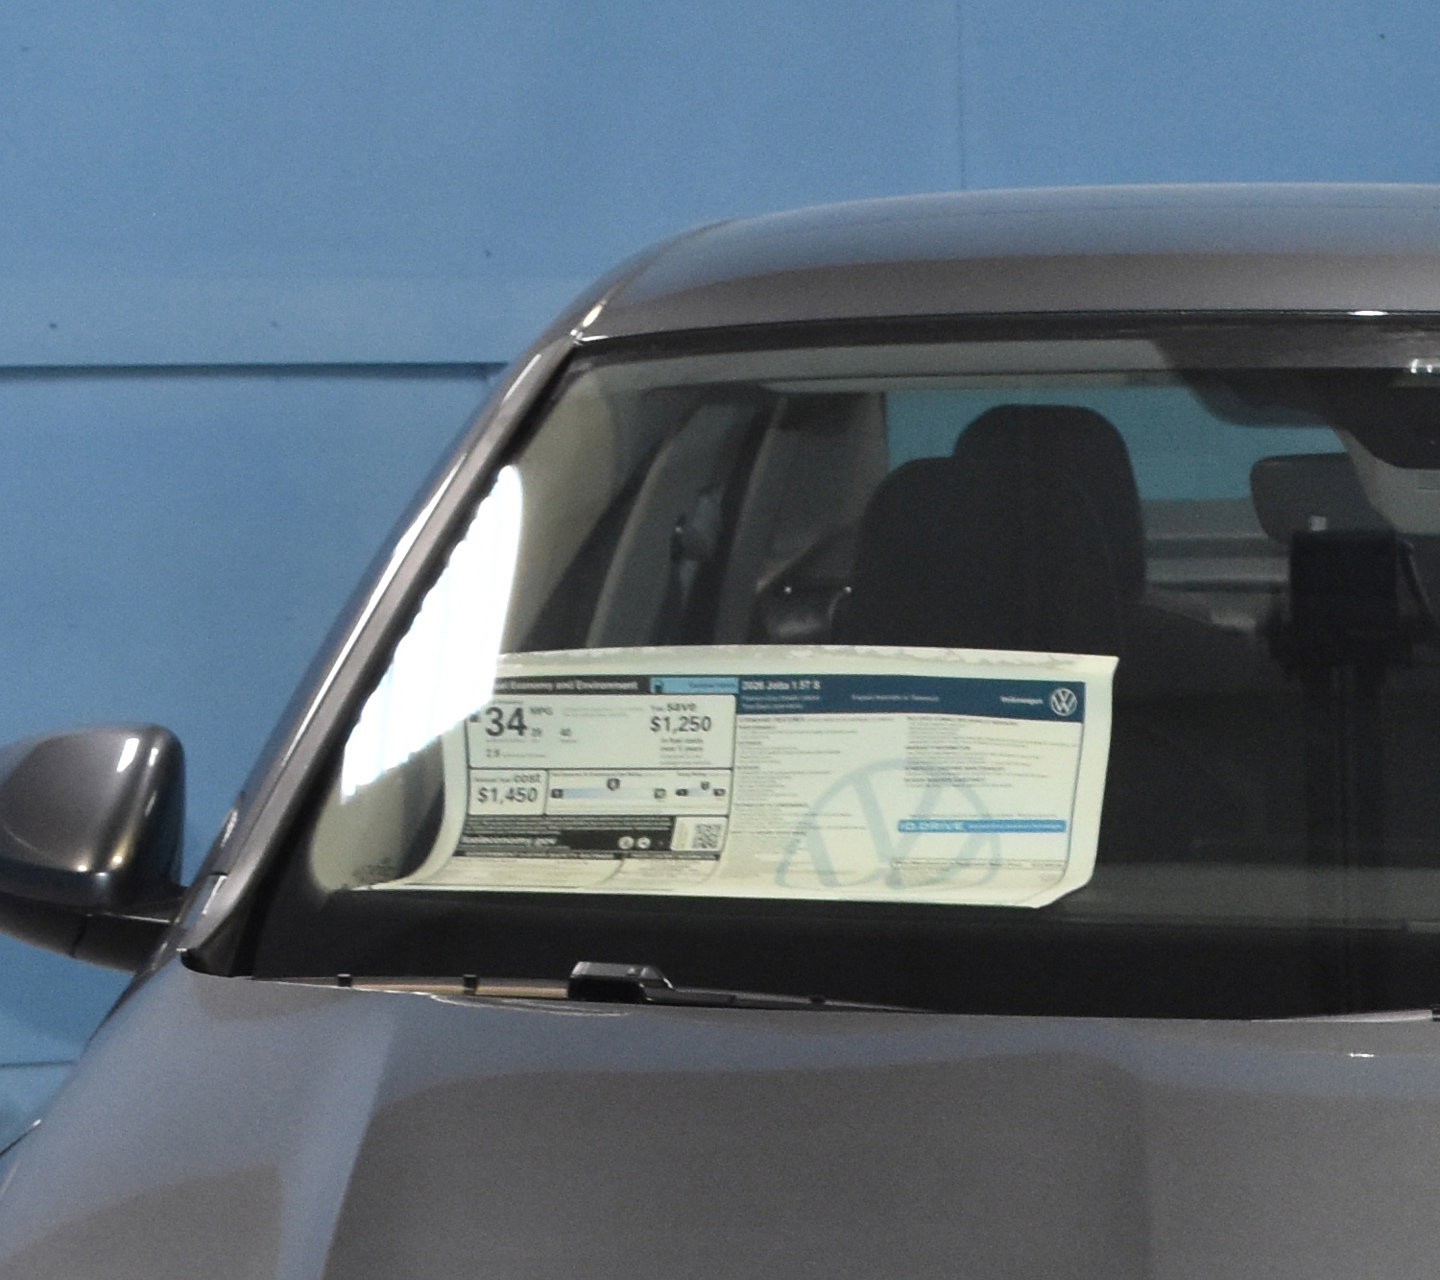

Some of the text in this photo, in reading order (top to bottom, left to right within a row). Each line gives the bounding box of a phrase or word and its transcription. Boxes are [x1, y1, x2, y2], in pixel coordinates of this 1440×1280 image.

[666, 702, 697, 712] save
[485, 706, 528, 737] 34
[649, 714, 713, 734] $1,250
[513, 773, 541, 783] cost
[477, 786, 538, 805] $1,450
